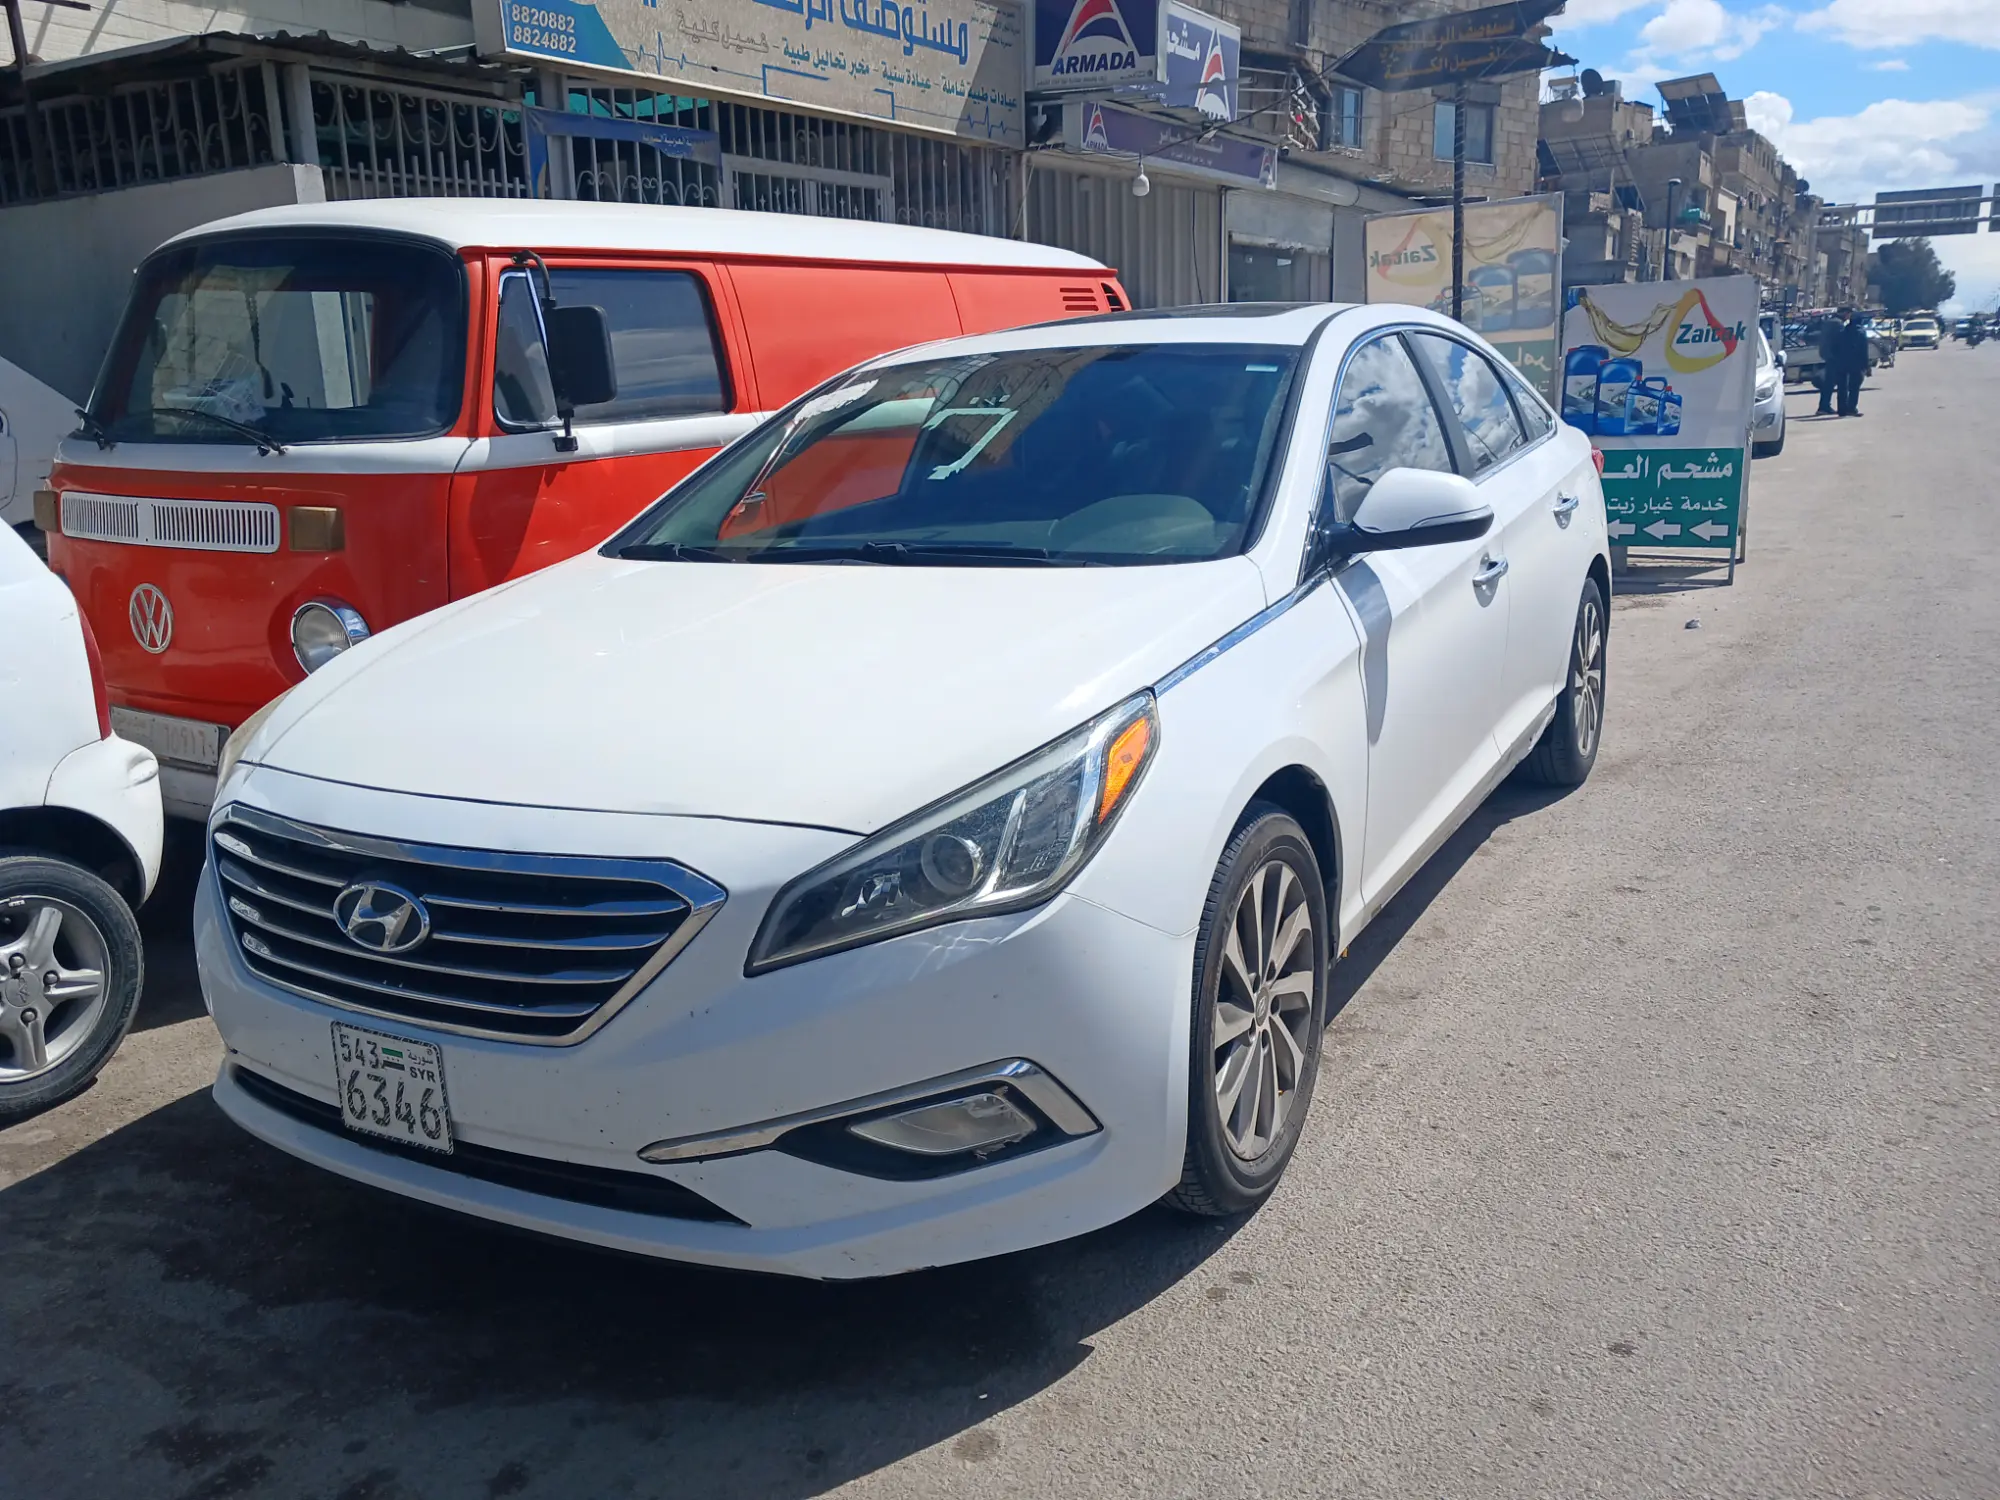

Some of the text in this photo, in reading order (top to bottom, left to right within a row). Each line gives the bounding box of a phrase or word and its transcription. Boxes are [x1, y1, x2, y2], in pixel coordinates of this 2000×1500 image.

[512, 4, 575, 33] 8820882
[513, 26, 576, 53] 8824882
[782, 36, 811, 65] طبية
[1165, 22, 1200, 61] مشح
[813, 48, 847, 71] تحاليل
[849, 58, 870, 80] مخبر
[1052, 51, 1136, 76] ARMADA
[881, 61, 904, 88] سنية
[906, 68, 931, 93] عيادة
[942, 75, 965, 97] شاملة
[967, 82, 989, 105] طبية
[990, 89, 1017, 112] عيادات
[1676, 321, 1747, 344] Zaitak
[1600, 452, 1733, 488] مشحم الع
[1607, 496, 1728, 514] خدمة غيار زيت
[338, 1033, 379, 1069] 543
[407, 1049, 434, 1066] سورية
[409, 1066, 436, 1083] SYR
[346, 1069, 442, 1140] 6346
